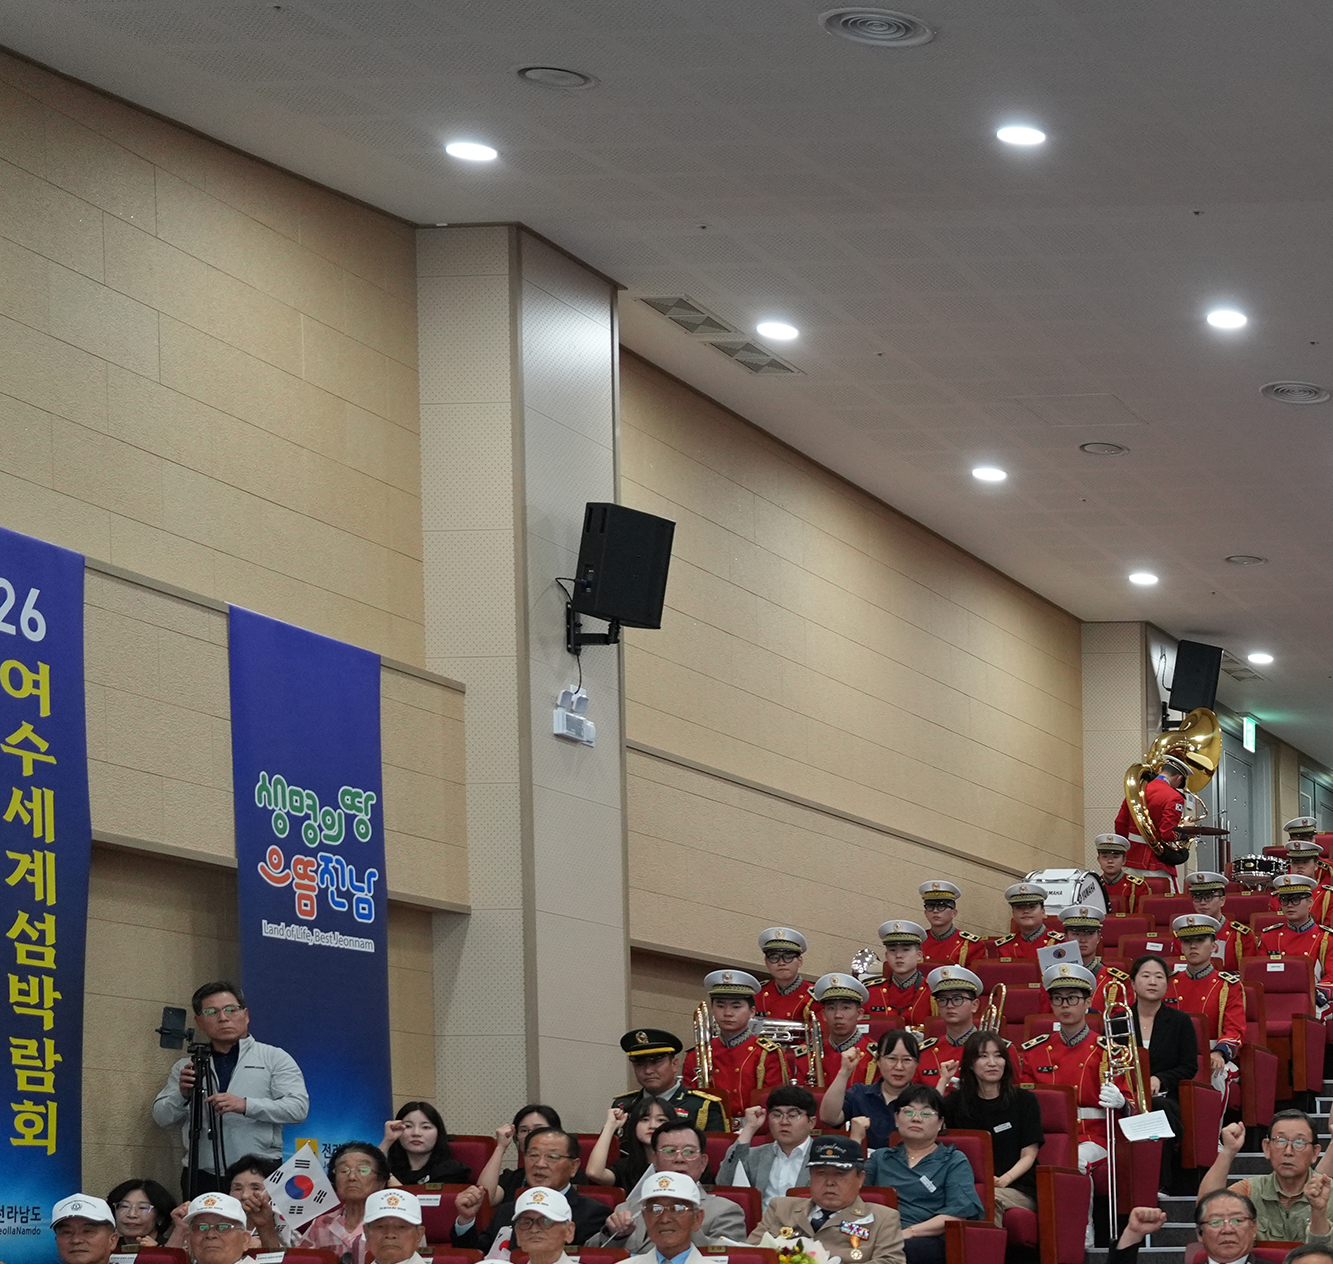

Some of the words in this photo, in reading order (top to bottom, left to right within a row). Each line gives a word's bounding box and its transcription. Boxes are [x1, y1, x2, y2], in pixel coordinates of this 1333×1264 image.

[0, 657, 63, 1156] 여수세계섬박람회
[262, 920, 286, 939] Land
[286, 924, 296, 939] of
[296, 925, 314, 945] Life,
[314, 928, 335, 946] Best
[335, 932, 375, 952] Jeonnam
